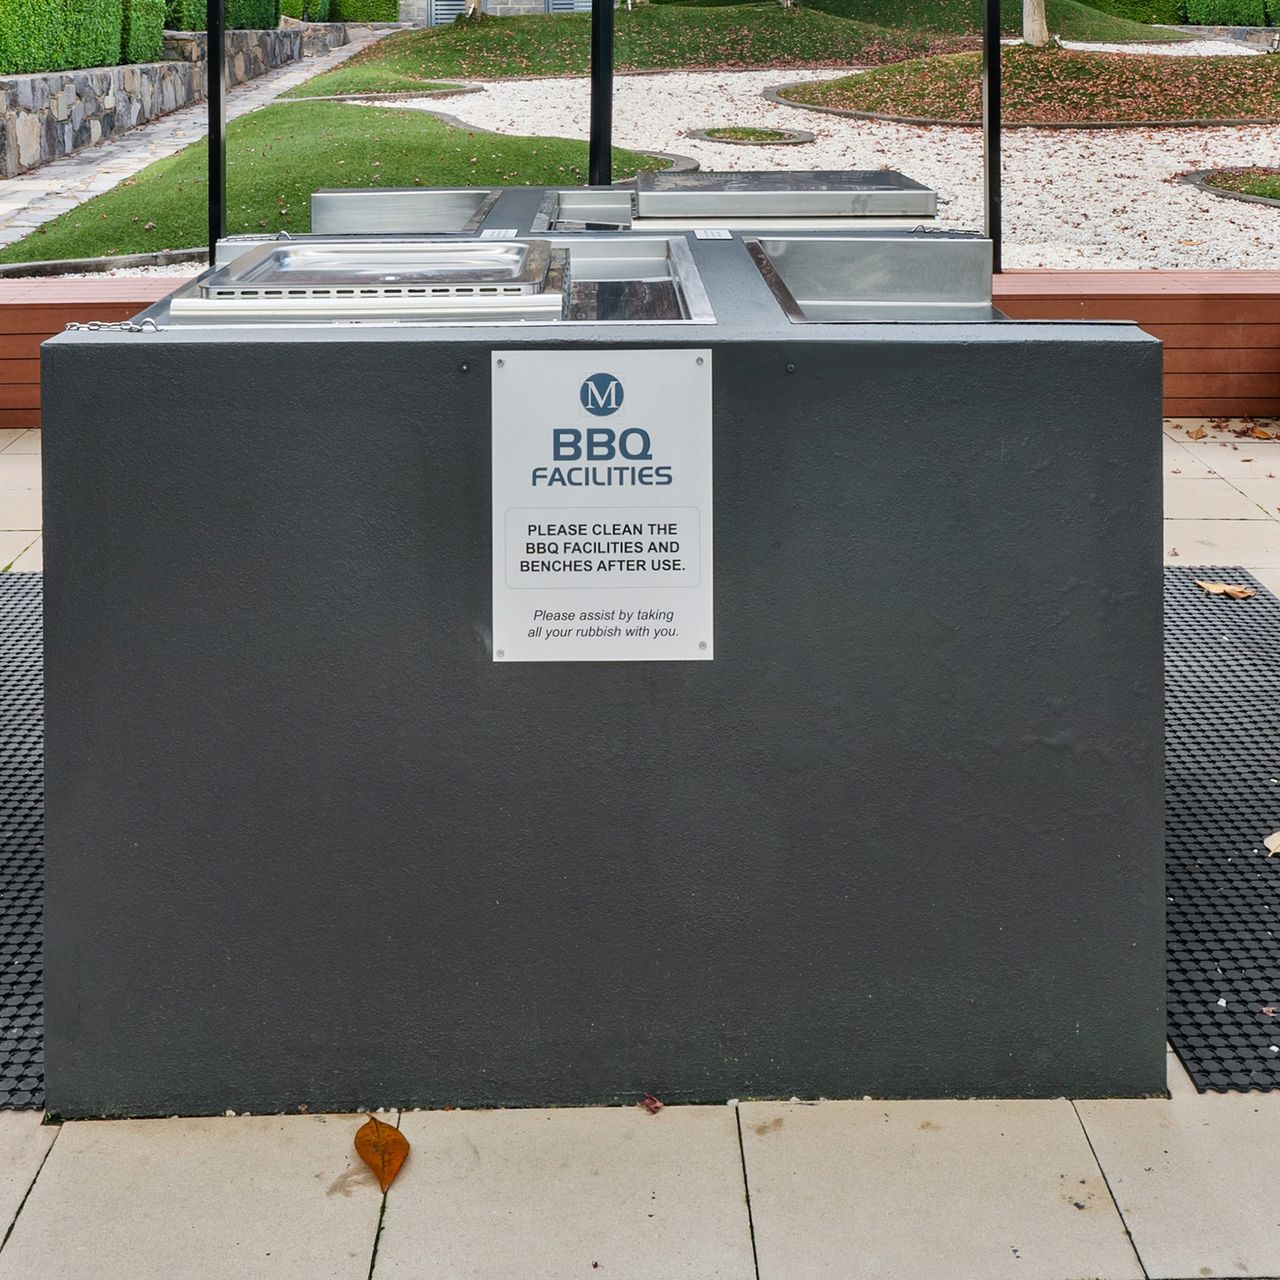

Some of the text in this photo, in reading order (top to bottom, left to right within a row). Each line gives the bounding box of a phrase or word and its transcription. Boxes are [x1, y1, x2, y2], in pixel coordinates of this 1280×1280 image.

[584, 380, 620, 409] M
[552, 427, 653, 461] BBQ
[531, 465, 673, 487] FACILITIES
[527, 523, 678, 536] PLEASE CLEAN THE
[525, 541, 680, 555] BBQ FACILITIES AND
[520, 559, 686, 573] BENCHES AFTER USE.
[533, 608, 675, 624] Please assist by taking
[527, 625, 680, 641] all your rubbish with you.
